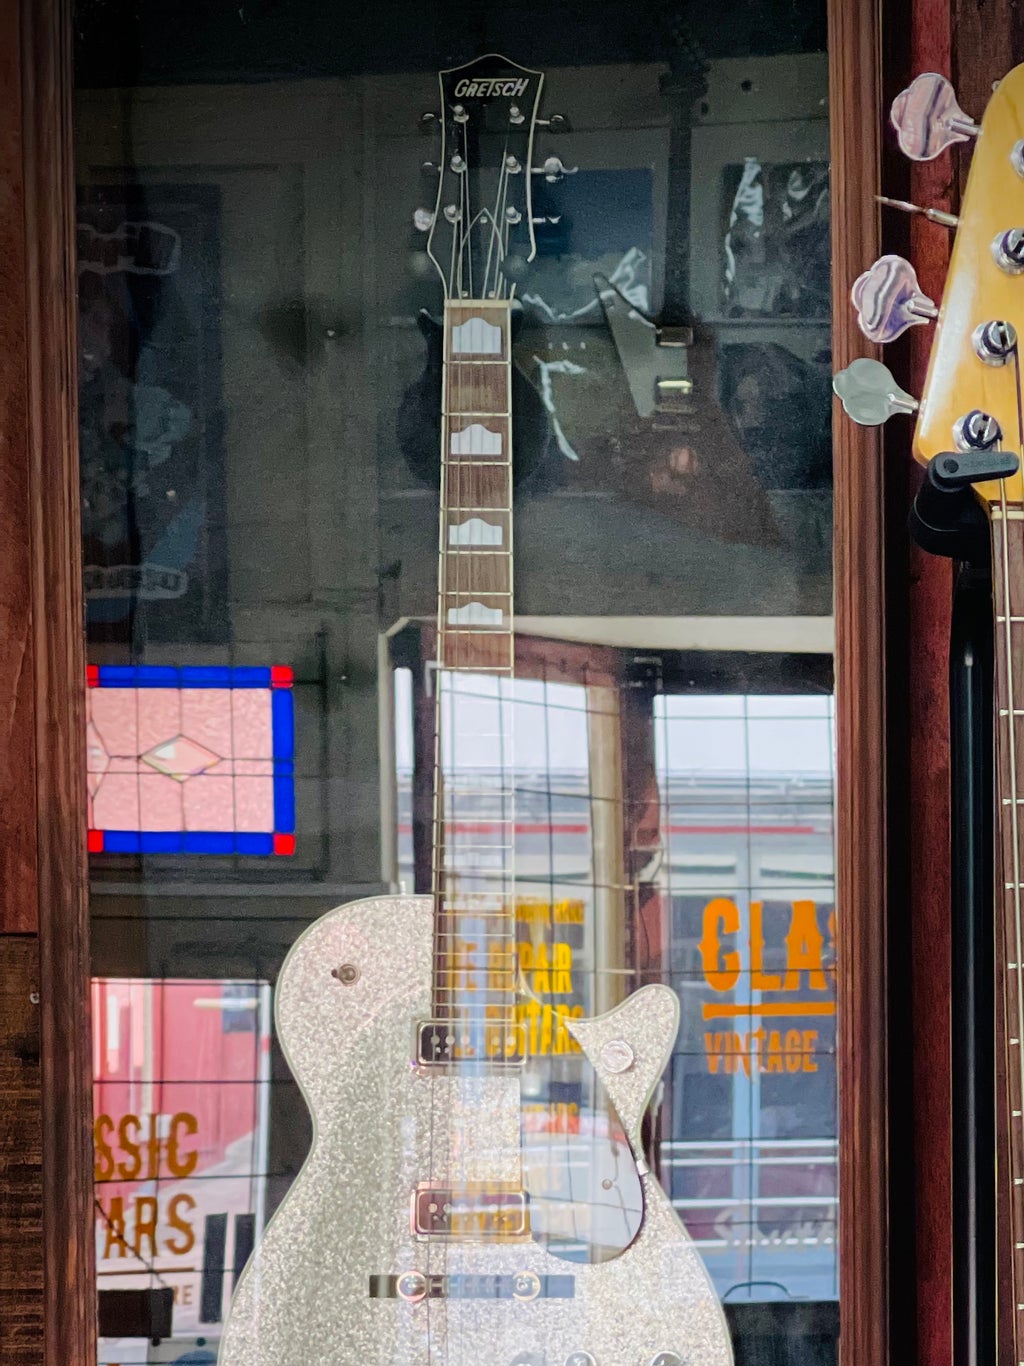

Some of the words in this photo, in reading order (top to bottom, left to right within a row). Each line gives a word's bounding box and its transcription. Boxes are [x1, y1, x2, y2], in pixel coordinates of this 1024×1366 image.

[454, 77, 530, 98] GRETSCH
[697, 897, 835, 991] CLA
[704, 1026, 819, 1083] VINTAGE
